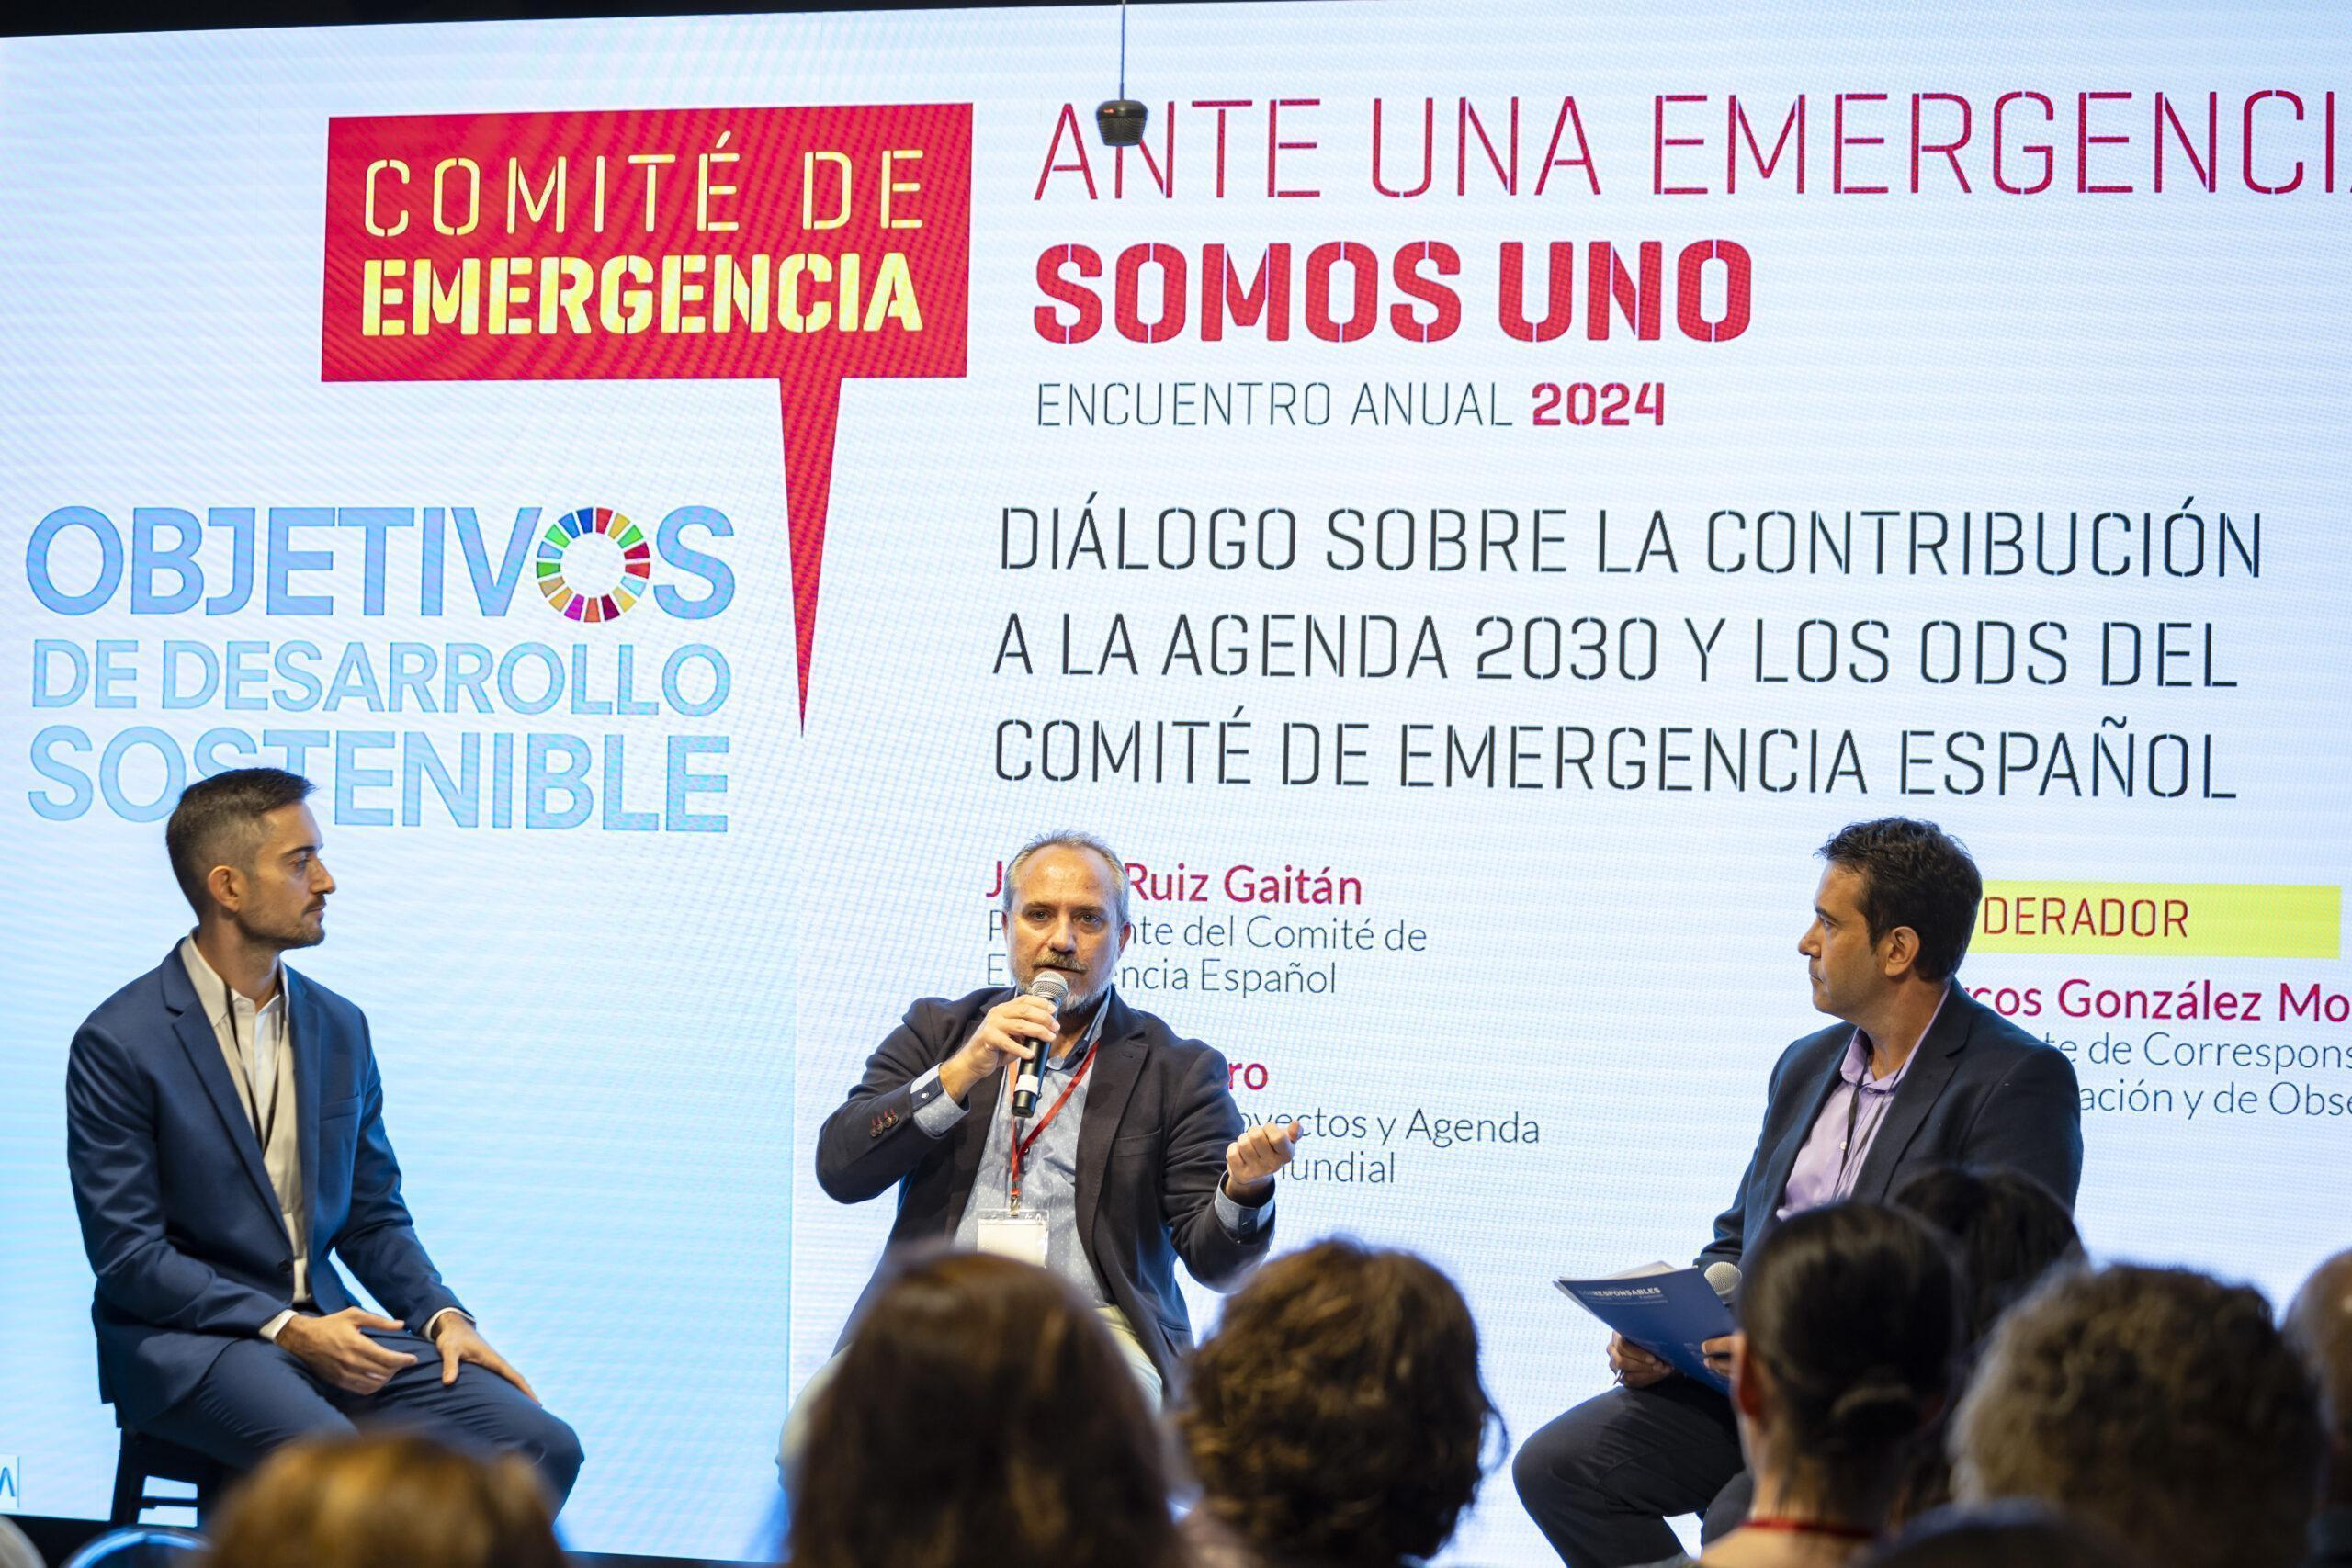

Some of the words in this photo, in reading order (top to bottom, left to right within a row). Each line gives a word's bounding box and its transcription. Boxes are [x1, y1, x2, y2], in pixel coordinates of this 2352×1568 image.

[1035, 96, 1320, 200] ANTE
[1373, 96, 1600, 197] UNA
[1655, 90, 2352, 194] EMERGENCI
[366, 131, 739, 236] COMITÉ
[803, 150, 922, 230] DE
[363, 253, 922, 335] EMERGENCIA
[1035, 242, 1461, 344] SOMOS
[1499, 240, 1751, 342] UNO
[1038, 382, 1330, 426] ENCUENTRO
[1351, 382, 1512, 426] ANUAL
[1532, 383, 1664, 425] 2024
[1001, 492, 1295, 570] DIÁLOGO
[1327, 509, 1566, 572] SOBRE
[1600, 510, 1678, 573] LA
[1708, 496, 2260, 578] CONTRIBUCIÓN
[993, 613, 1033, 674] A
[1062, 614, 1137, 675] LA
[1162, 614, 1447, 678] AGENDA
[1476, 616, 1657, 680] 2030
[1685, 618, 1725, 681] Y
[1756, 619, 1888, 683] LOS
[1921, 621, 2067, 684] ODS
[2102, 622, 2237, 687] DEL
[32, 638, 139, 708] DE
[162, 640, 731, 717] DESARROLLO
[996, 705, 1251, 784] COMITÉ
[1283, 723, 1368, 785] DE
[1401, 725, 1867, 794] EMERGENCIA
[1901, 716, 2236, 798] ESPAÑOL
[1125, 861, 1209, 901] Ruiz
[1225, 865, 1361, 904] Gaitán
[1183, 915, 1234, 947] del
[1247, 915, 1374, 950] Comité
[1385, 919, 1427, 952] de
[1984, 897, 2188, 937] DERADOR
[1201, 958, 1335, 998] Español
[2059, 979, 2261, 1021] González
[2088, 1032, 2132, 1065] de
[2079, 1078, 2172, 1111] ación
[2184, 1091, 2203, 1120] y
[2214, 1082, 2257, 1114] de
[2269, 1082, 2352, 1116] Obs
[1377, 1118, 1396, 1145] y
[1406, 1108, 1539, 1148] Agenda
[1281, 1150, 1395, 1183] undial
